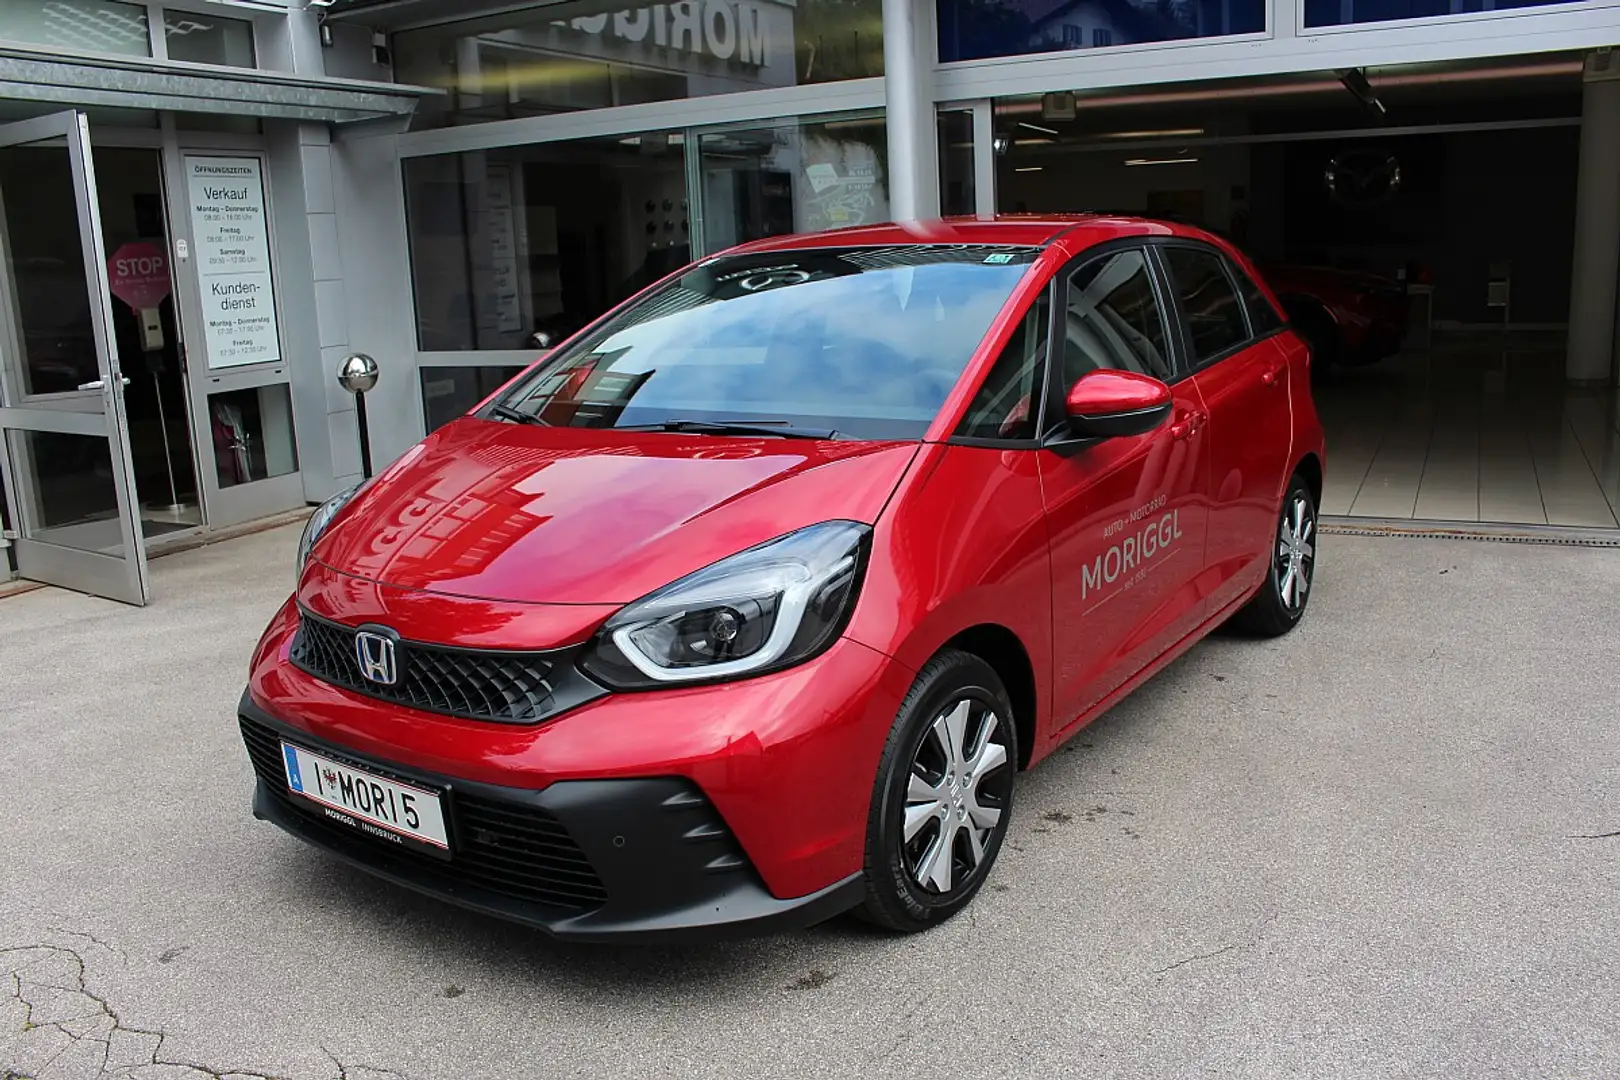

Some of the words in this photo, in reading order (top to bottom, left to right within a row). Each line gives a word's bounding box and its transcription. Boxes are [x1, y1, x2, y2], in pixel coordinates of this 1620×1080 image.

[194, 165, 252, 174] ÖFFNUNGSZEITEN
[204, 187, 248, 200] Verkauf
[196, 205, 220, 213] Montag
[116, 256, 163, 276] STOP
[212, 282, 261, 296] Kunden-
[221, 297, 256, 311] dienst
[238, 317, 270, 325] Donnerstag
[233, 339, 253, 347] Freitag
[1103, 519, 1123, 540] AUTO
[1129, 494, 1167, 525] MOTORRAD
[1082, 509, 1182, 601] MORIGGL
[315, 762, 323, 795] I
[338, 771, 398, 824] MORI
[401, 793, 420, 829] 5
[324, 808, 356, 827] MORIGGL
[362, 822, 403, 844] INNSBRUCK
